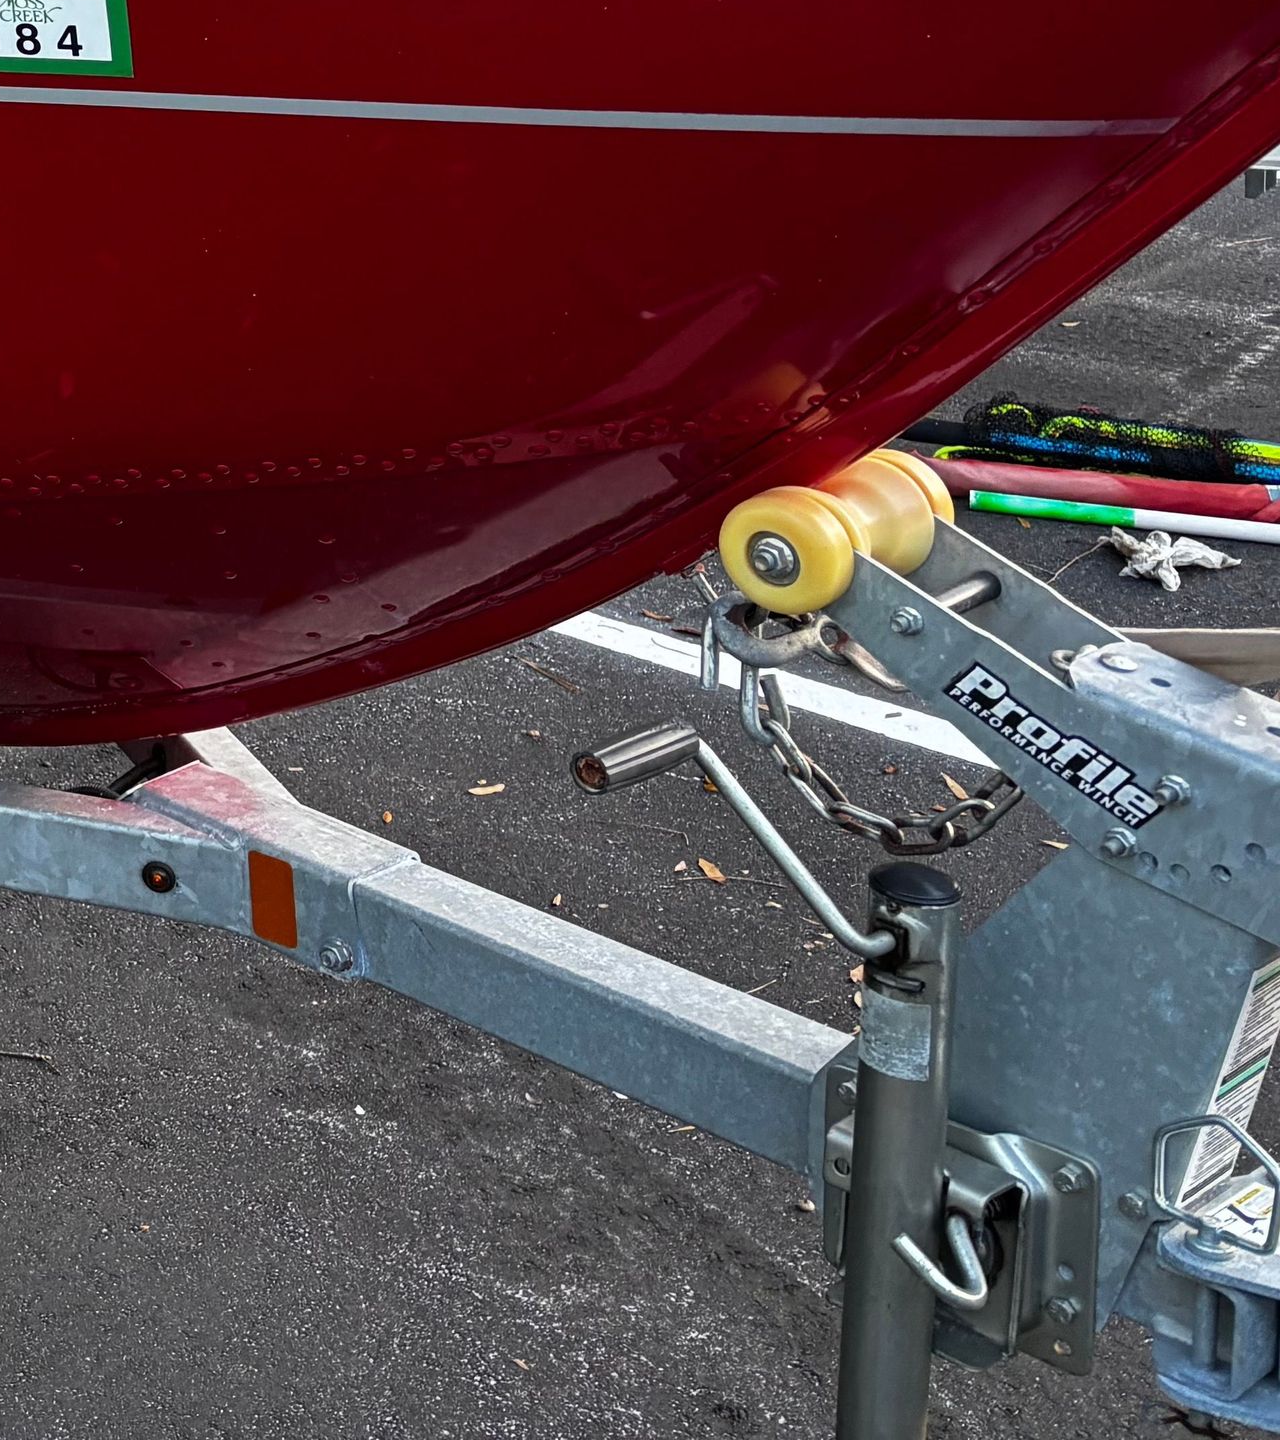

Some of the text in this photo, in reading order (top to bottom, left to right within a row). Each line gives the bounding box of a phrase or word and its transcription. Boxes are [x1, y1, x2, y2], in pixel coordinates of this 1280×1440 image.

[0, 7, 62, 23] CREEK
[948, 687, 1141, 827] PERFORMANCE WINCH
[955, 665, 1160, 821] Profile
